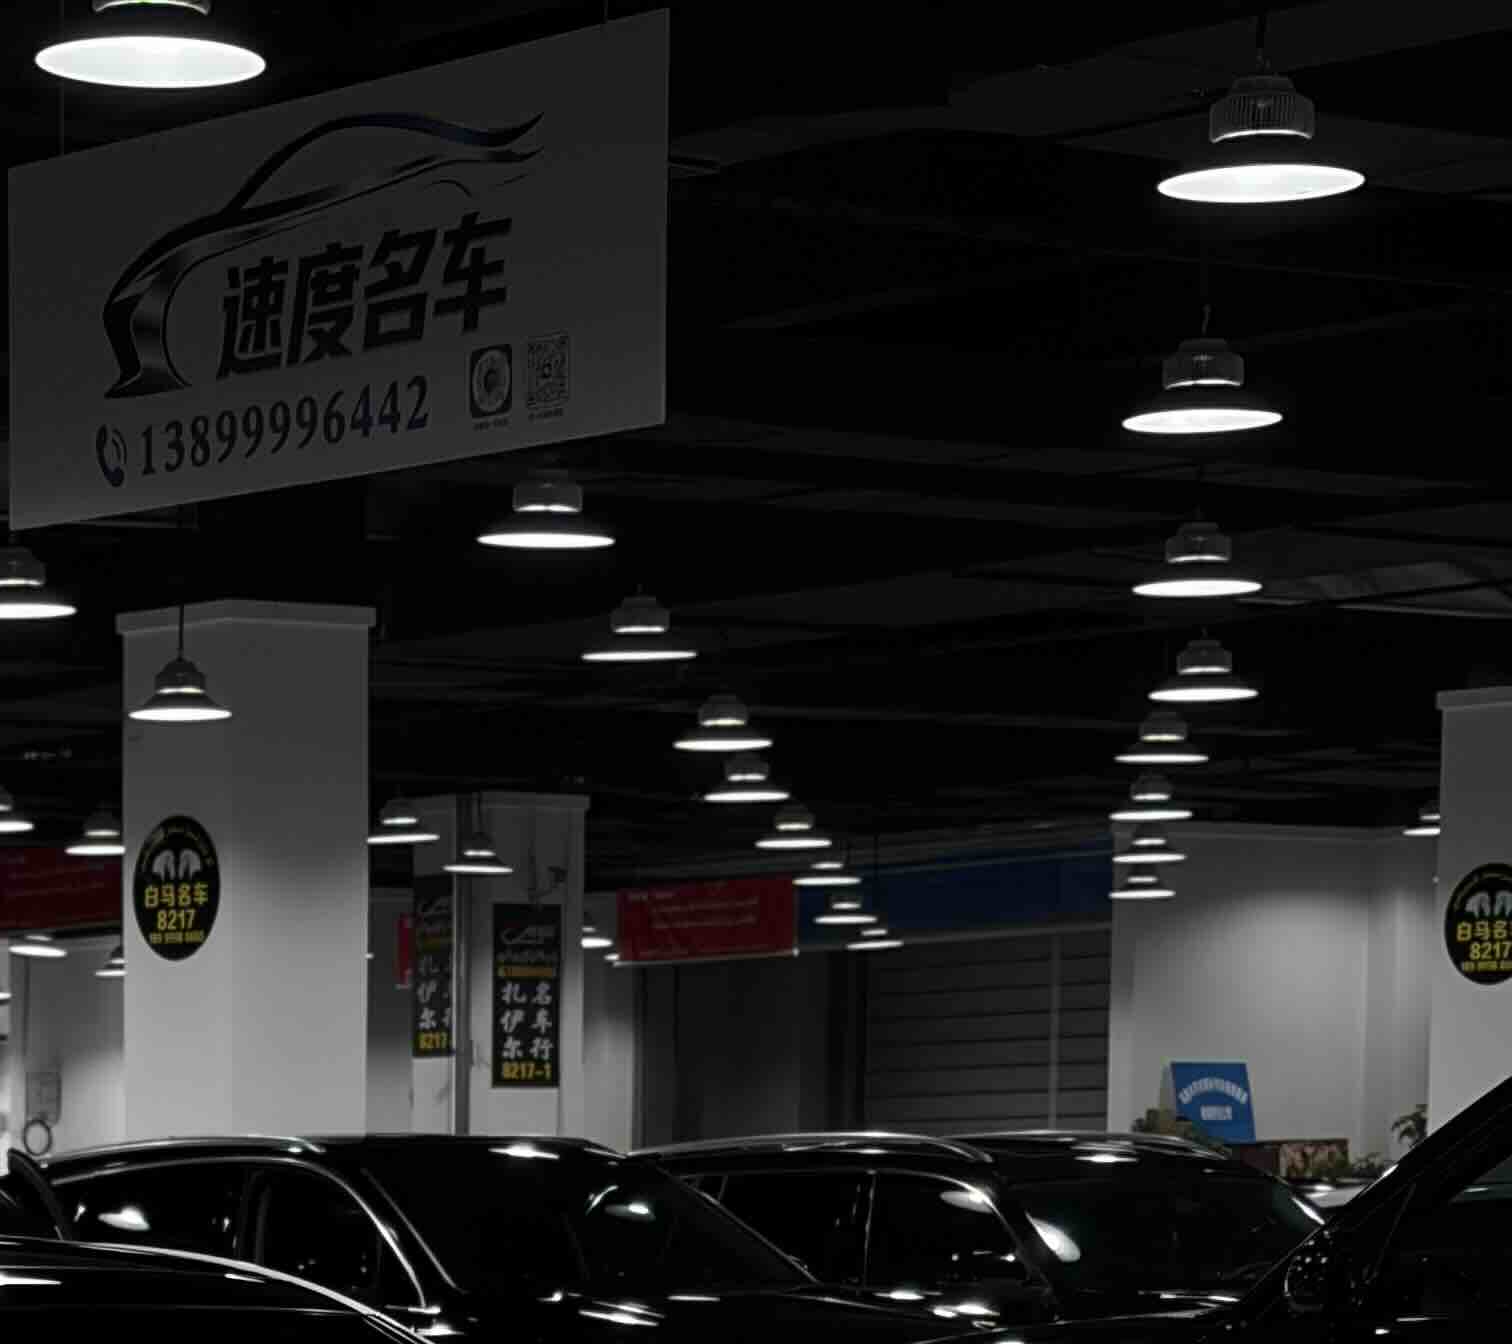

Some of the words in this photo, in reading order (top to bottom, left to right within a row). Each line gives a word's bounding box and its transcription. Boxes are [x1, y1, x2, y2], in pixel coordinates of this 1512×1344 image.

[215, 211, 513, 381] 速度名车
[140, 375, 430, 477] 13899996442
[144, 882, 209, 908] 白马名车
[157, 909, 196, 931] 8217
[1456, 920, 1512, 942] 白马名
[1469, 941, 1512, 961] 8217
